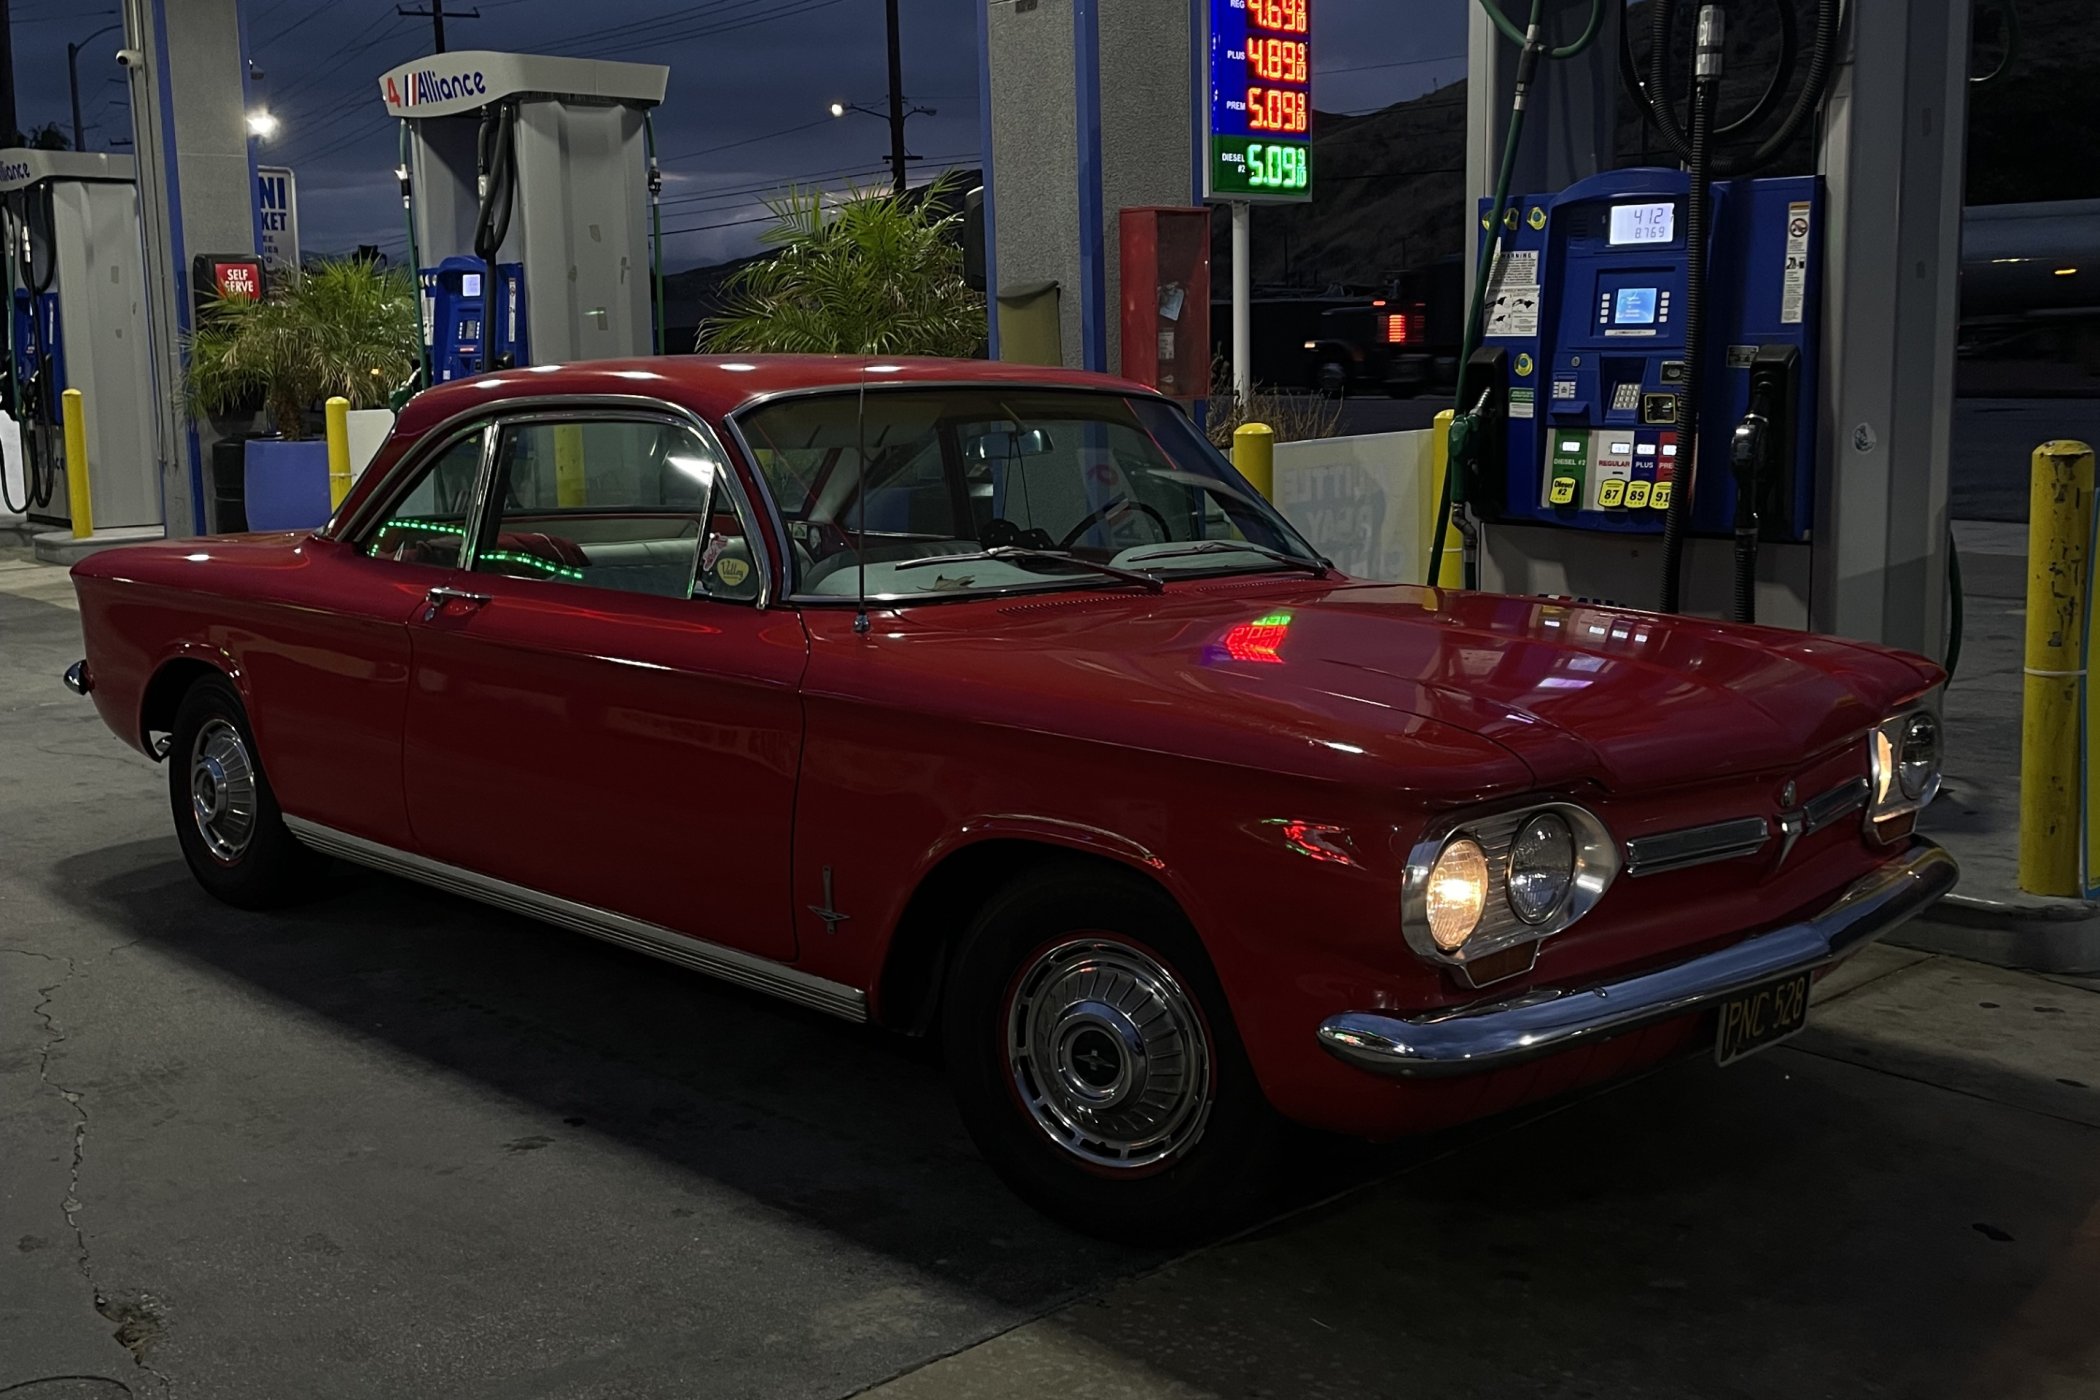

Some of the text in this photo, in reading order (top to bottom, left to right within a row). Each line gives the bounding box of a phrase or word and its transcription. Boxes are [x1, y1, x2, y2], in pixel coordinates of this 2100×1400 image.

[1229, 0, 1245, 8] REG
[1227, 50, 1245, 61] PLUS
[1247, 37, 1296, 81] 4.89
[387, 71, 486, 108] 4 Alliance
[1226, 101, 1245, 111] PREM
[1247, 87, 1296, 130] 5.09
[1222, 153, 1245, 162] DIESEL
[1247, 144, 1296, 187] 5.09
[1238, 164, 1245, 173] #2
[227, 268, 249, 281] SELF
[224, 281, 254, 293] SERVE
[1598, 459, 1631, 467] REGULAR
[1635, 461, 1654, 469] PLUS
[1555, 480, 1574, 488] Diesel
[1604, 489, 1620, 500] 87
[1630, 490, 1645, 501] 89
[1655, 491, 1670, 503] 91
[1725, 976, 1806, 1051] PNC 528
